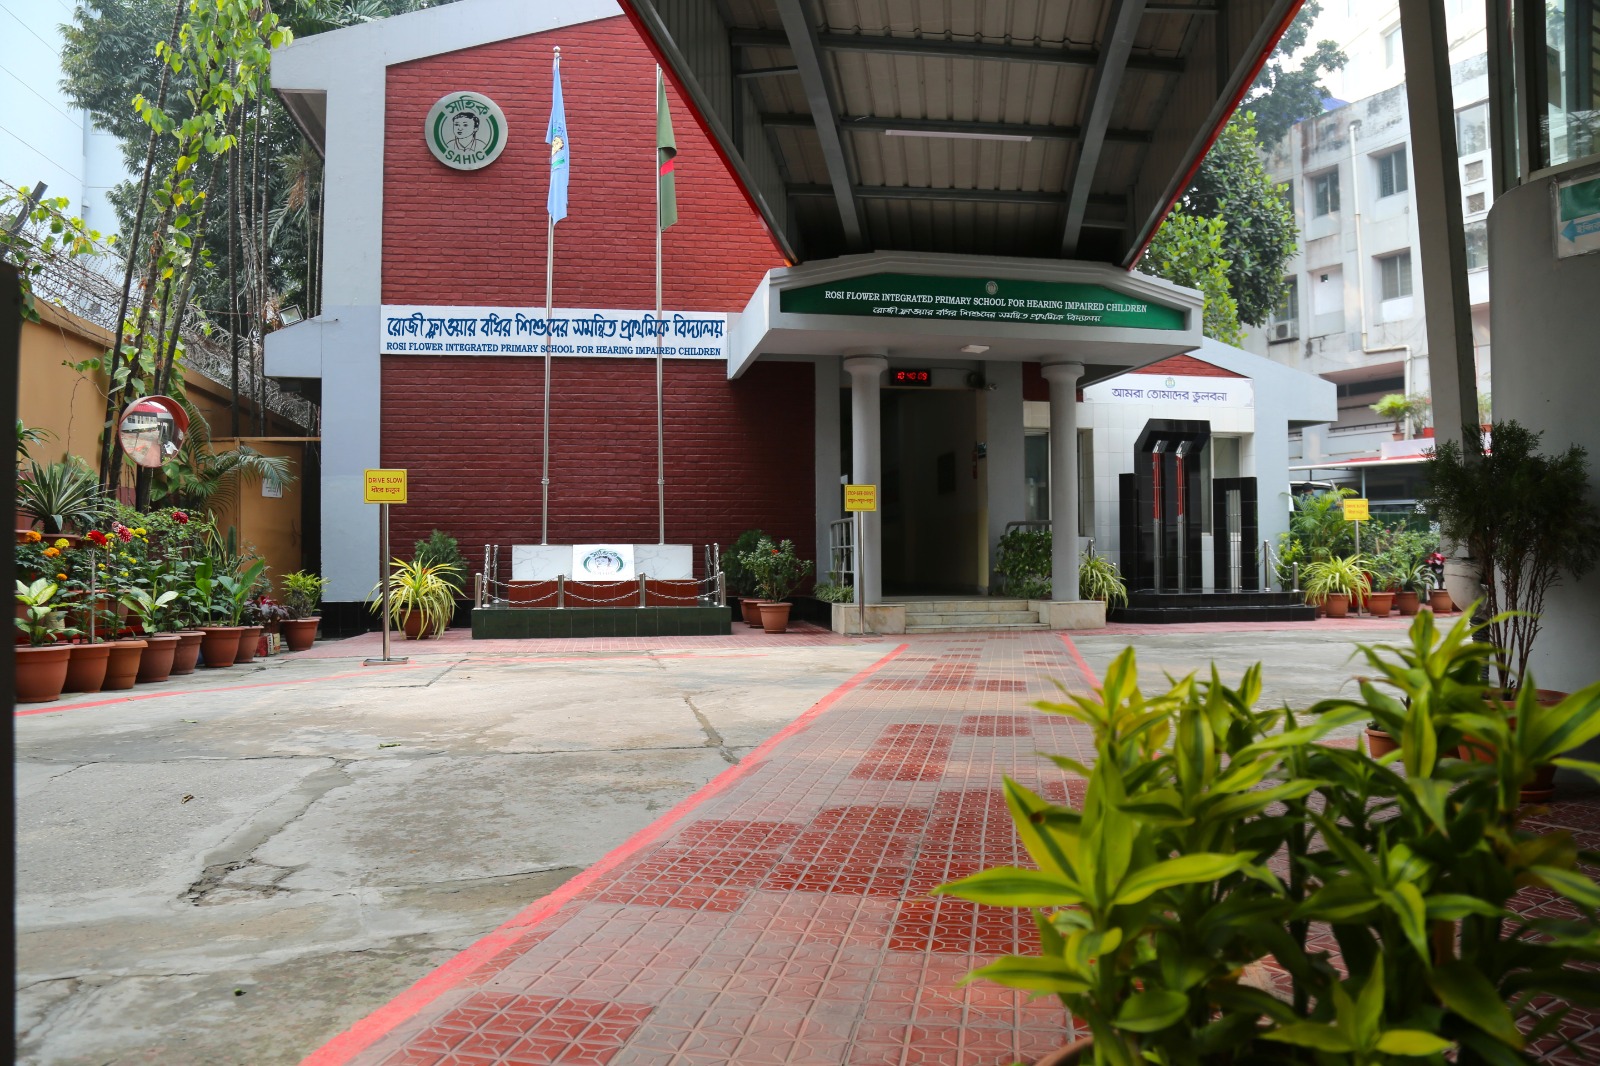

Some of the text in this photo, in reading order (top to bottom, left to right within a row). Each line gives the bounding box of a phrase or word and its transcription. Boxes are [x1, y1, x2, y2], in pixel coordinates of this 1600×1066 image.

[445, 95, 490, 115] সাহিক
[445, 150, 485, 164] SAHIC
[825, 291, 1147, 312] ROSI FLOWER INTEGRATED PRIMARY SCHOOL FOR HEARING IMPAIRED CHILDREN
[387, 312, 725, 341] রোজী ফ্লাওয়ার বধির শিশুদের সমন্বিত প্রাথমিক বিদ্যালয়
[386, 342, 721, 356] ROSI FLOWER INTEGRATED PRIMARY SCHOOL FOR HEARING IMPAIRED CHILDREN
[1112, 388, 1227, 403] আমরা তোমাদের ভুলবনা
